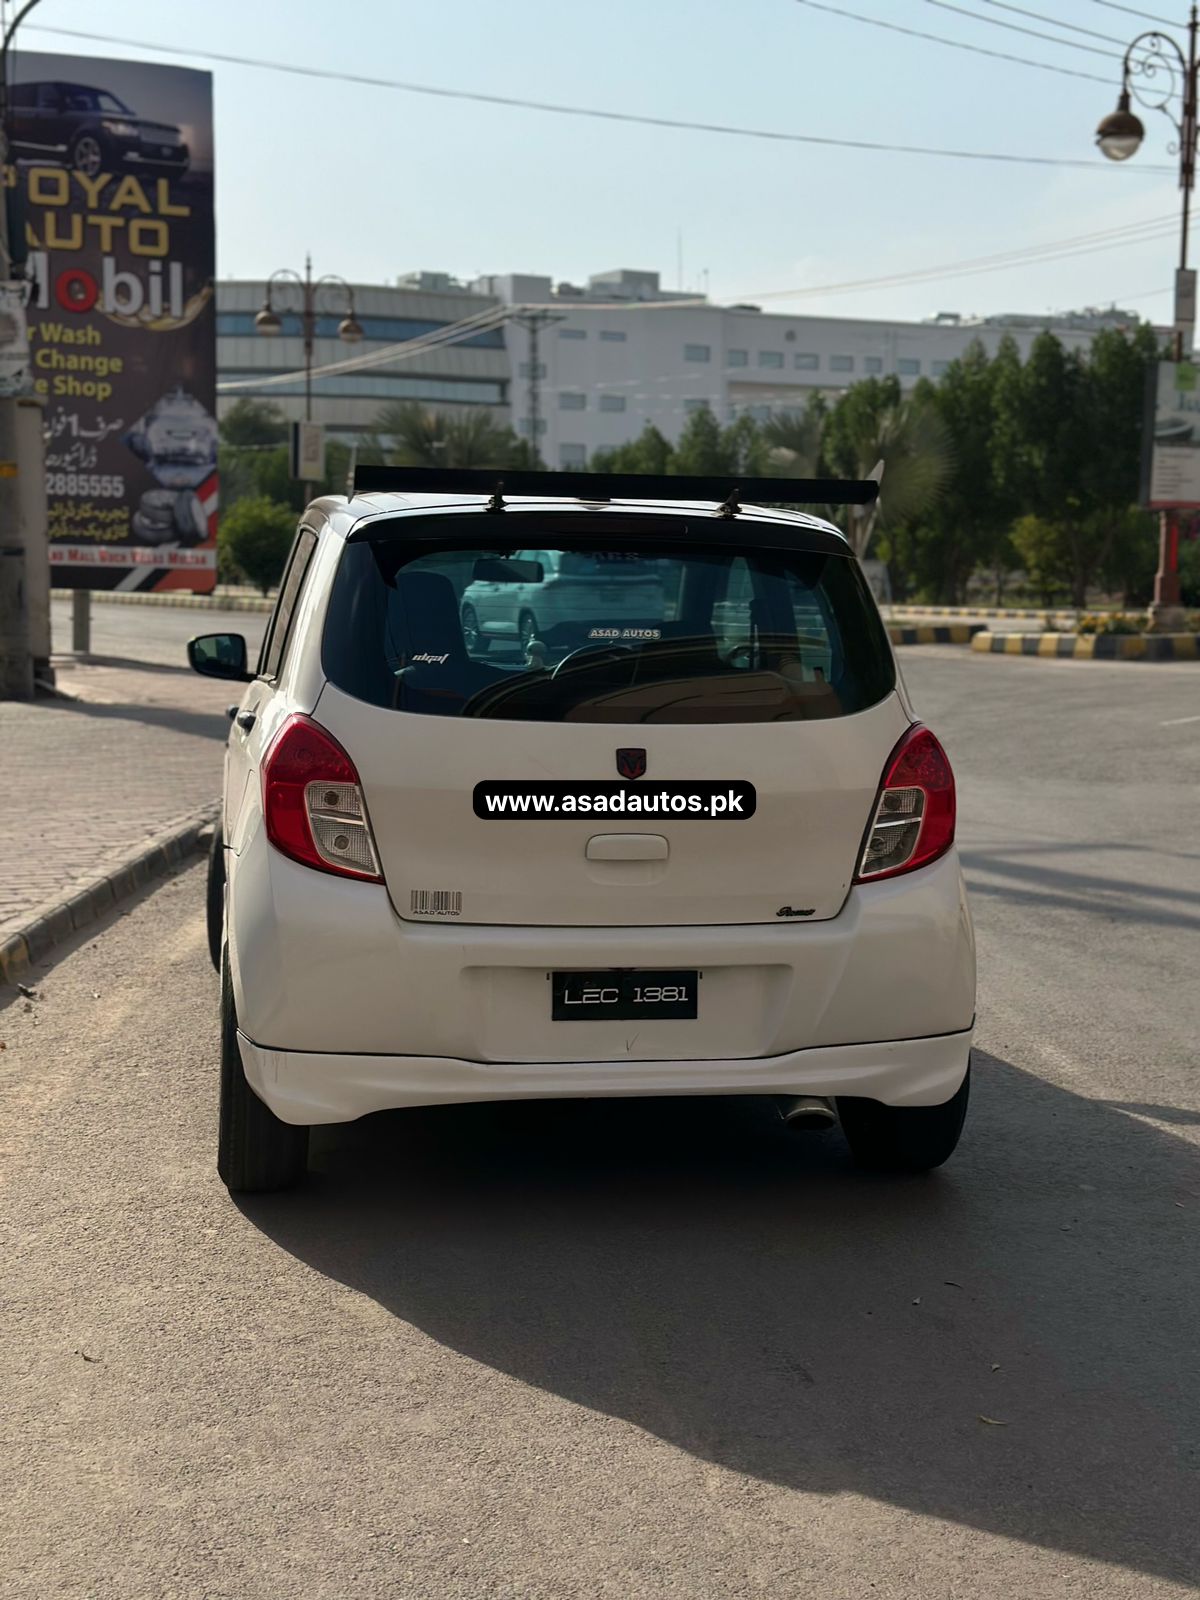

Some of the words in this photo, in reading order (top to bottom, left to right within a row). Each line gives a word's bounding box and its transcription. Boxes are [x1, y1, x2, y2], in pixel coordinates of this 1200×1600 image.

[41, 323, 102, 345] Wash
[35, 349, 123, 375] Change
[53, 376, 112, 401] Shop
[45, 473, 124, 498] 2885555
[589, 628, 620, 638] ASAD
[622, 628, 661, 639] AUTOS
[564, 988, 619, 1004] LEC
[633, 986, 688, 1002] 1381
